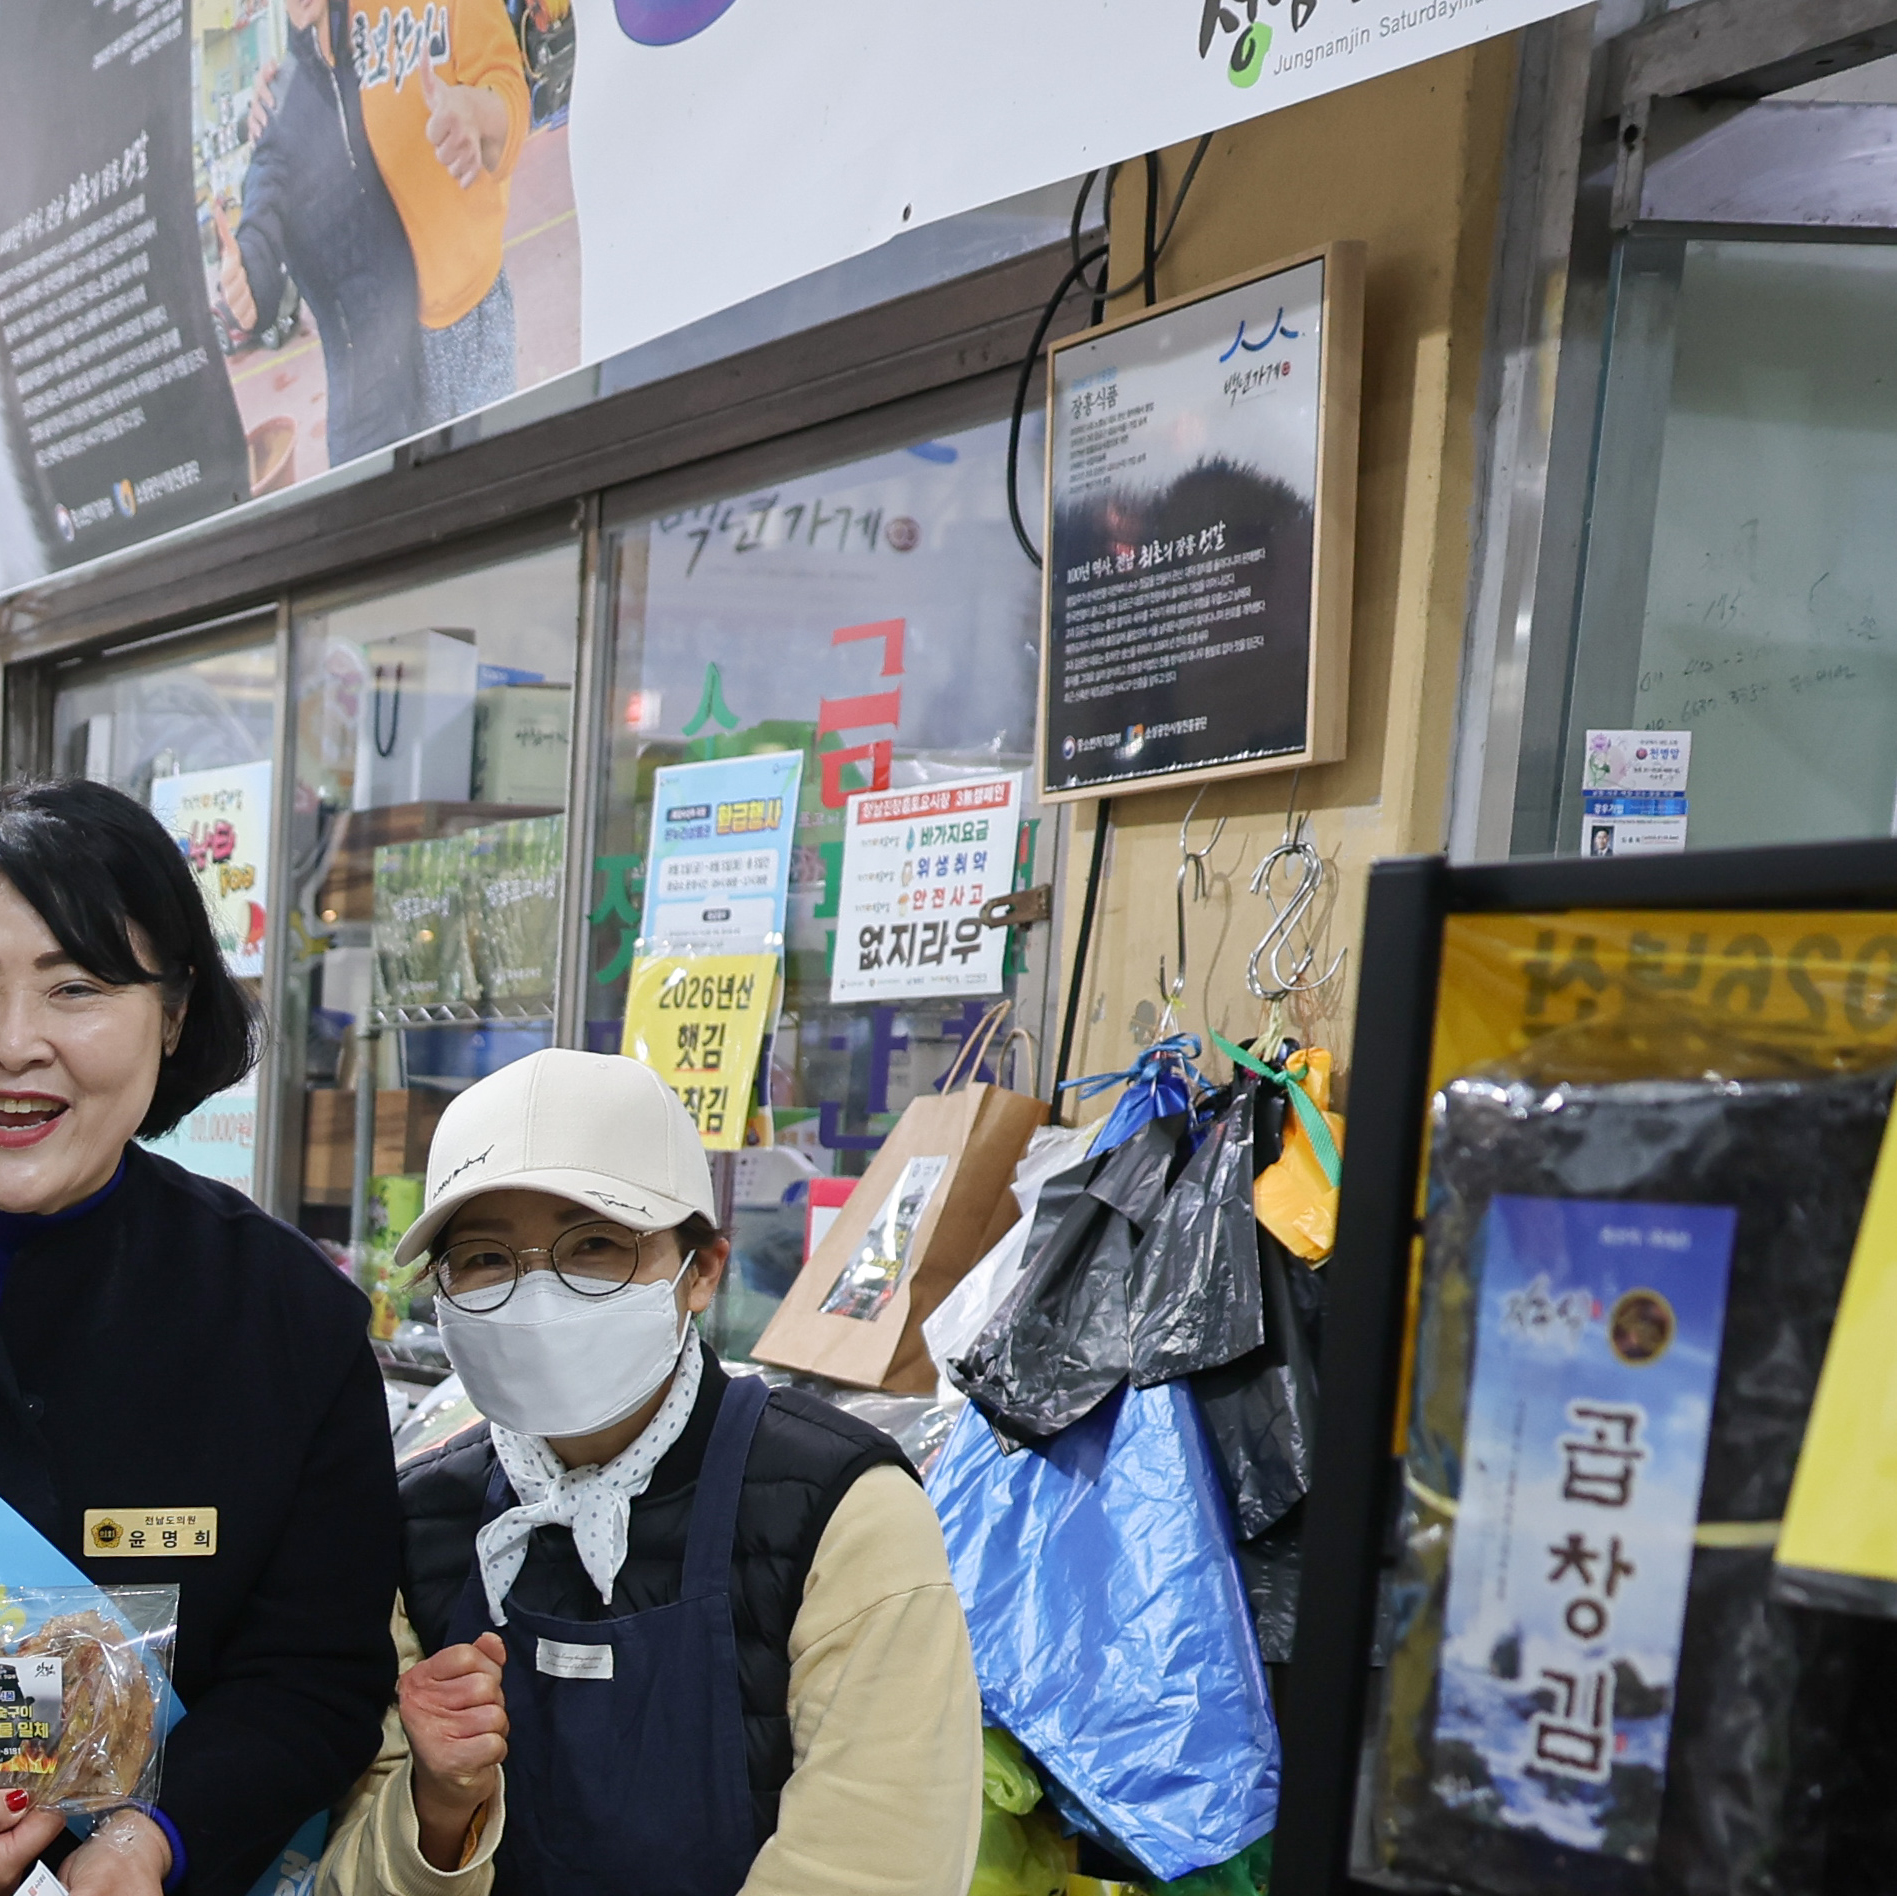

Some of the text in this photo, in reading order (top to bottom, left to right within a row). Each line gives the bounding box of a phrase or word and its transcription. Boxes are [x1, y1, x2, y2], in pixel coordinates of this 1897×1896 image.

[1274, 26, 1370, 76] Jungnamjin
[1379, 0, 1488, 38] Saturdaym
[1070, 383, 1118, 420] 장흥식품
[1223, 361, 1283, 407] 백년가게
[920, 819, 990, 847] 바가지요금
[859, 917, 982, 971] 없지라우
[659, 974, 755, 1010] 2026년산
[676, 1022, 727, 1069] 햇김
[673, 1085, 730, 1133] 창김
[145, 1515, 197, 1526] 전남도의원
[1533, 1404, 1646, 1776] 곱창김
[17, 1721, 50, 1740] 일체
